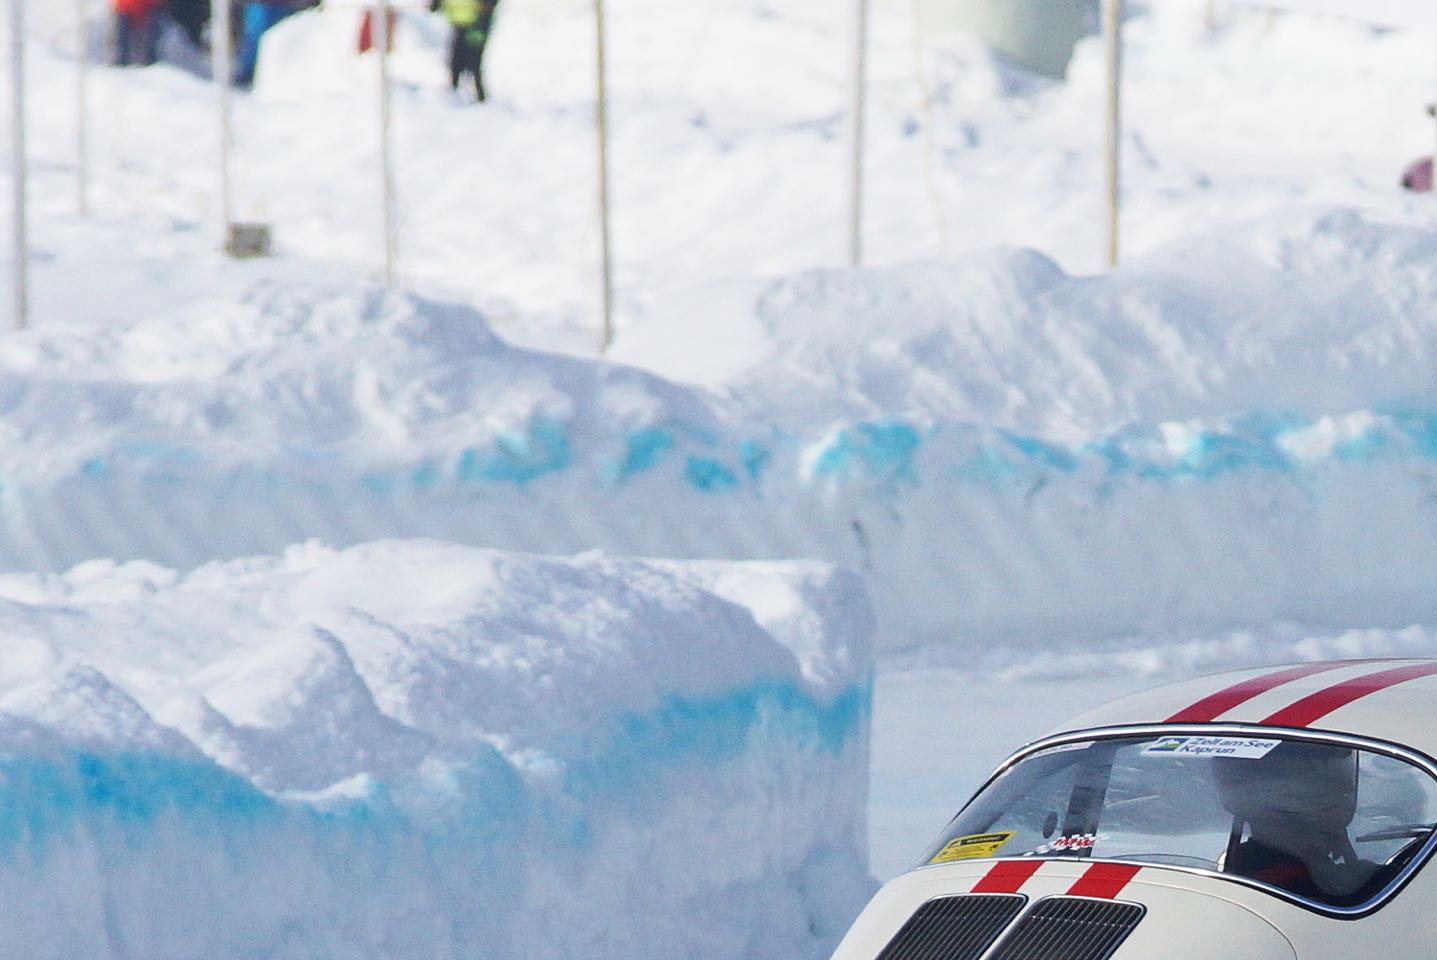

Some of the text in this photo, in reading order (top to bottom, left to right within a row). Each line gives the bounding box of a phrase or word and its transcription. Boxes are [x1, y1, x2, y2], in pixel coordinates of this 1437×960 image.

[1219, 739, 1244, 747] am
[1248, 738, 1274, 749] See
[1180, 744, 1235, 755] Kaprun
